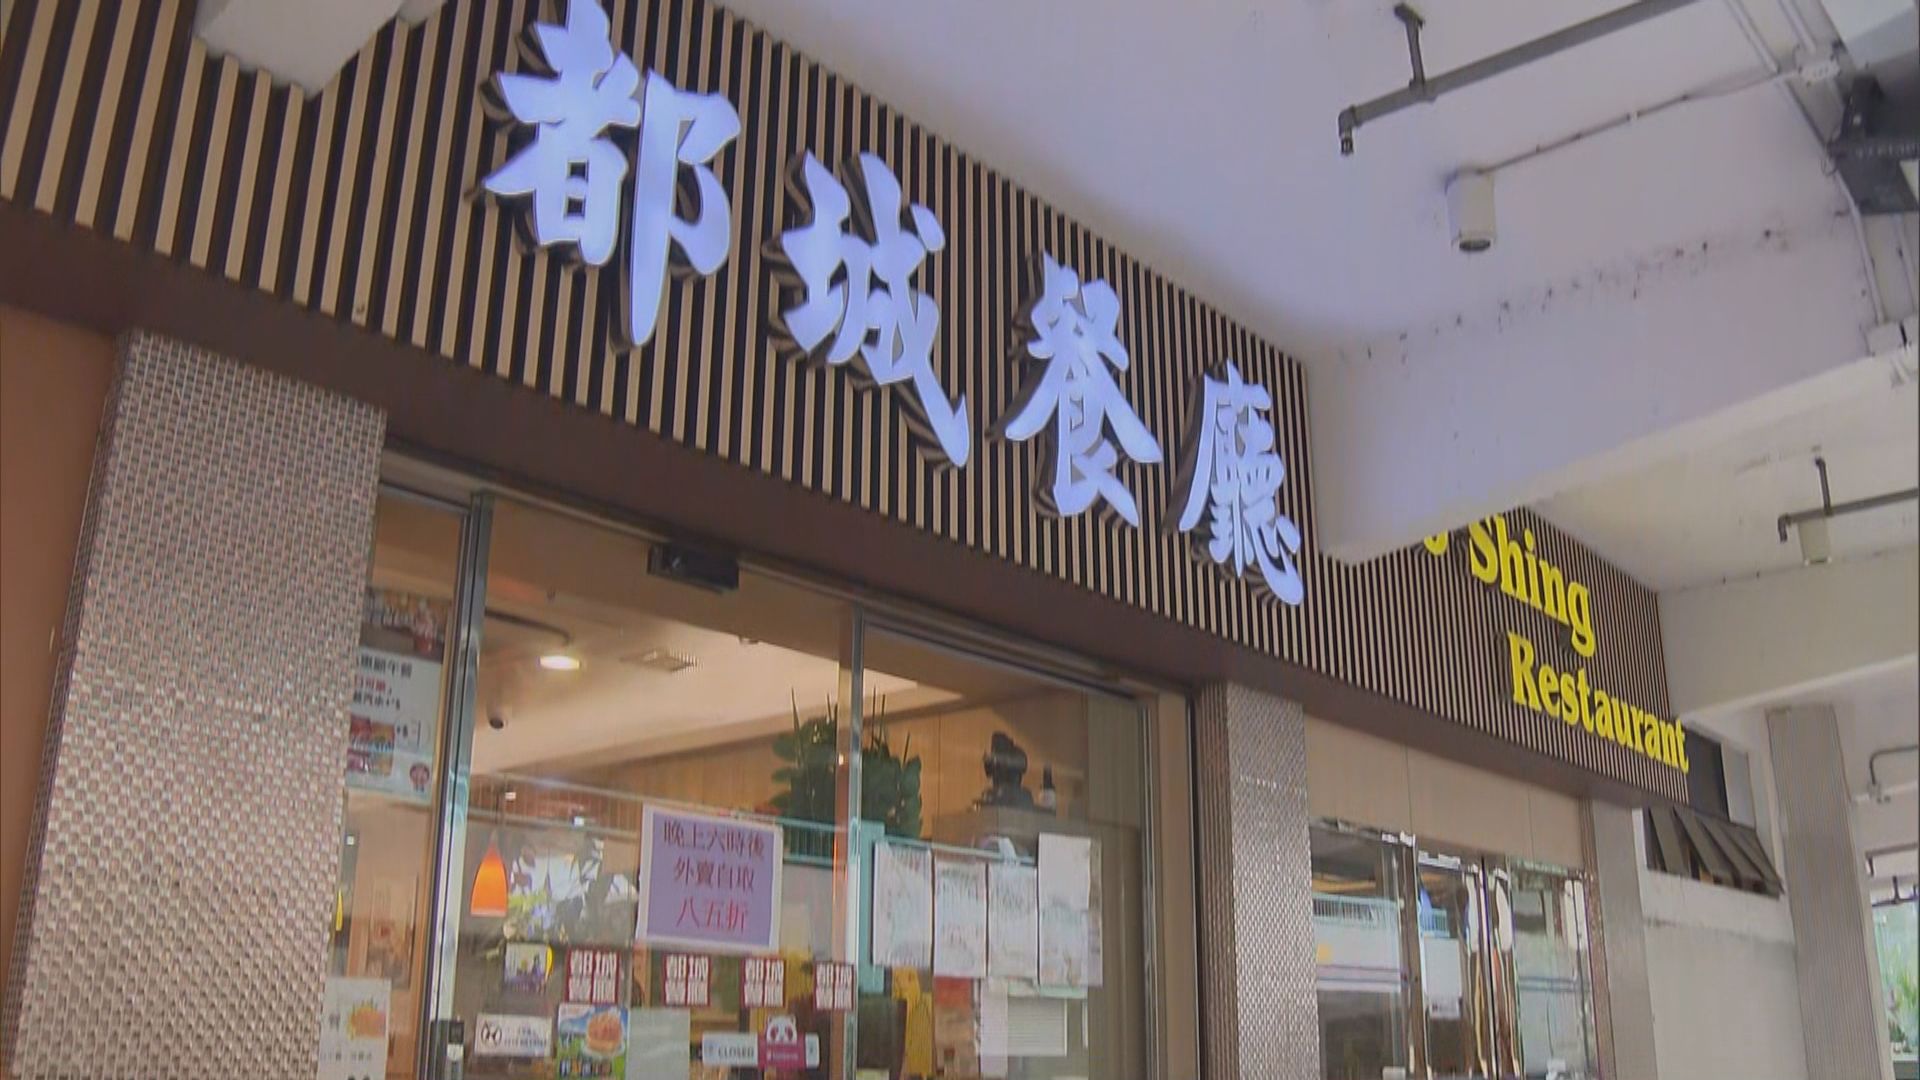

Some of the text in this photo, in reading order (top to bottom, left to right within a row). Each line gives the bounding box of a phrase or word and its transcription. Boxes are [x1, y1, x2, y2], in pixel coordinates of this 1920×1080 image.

[484, 0, 1304, 606] 都城餐廳
[1468, 513, 1595, 658] Shing
[1508, 631, 1689, 774] Restaurant
[663, 820, 765, 860] 晚上六時後
[674, 856, 755, 893] 外賣自取
[676, 896, 748, 934] 八五折
